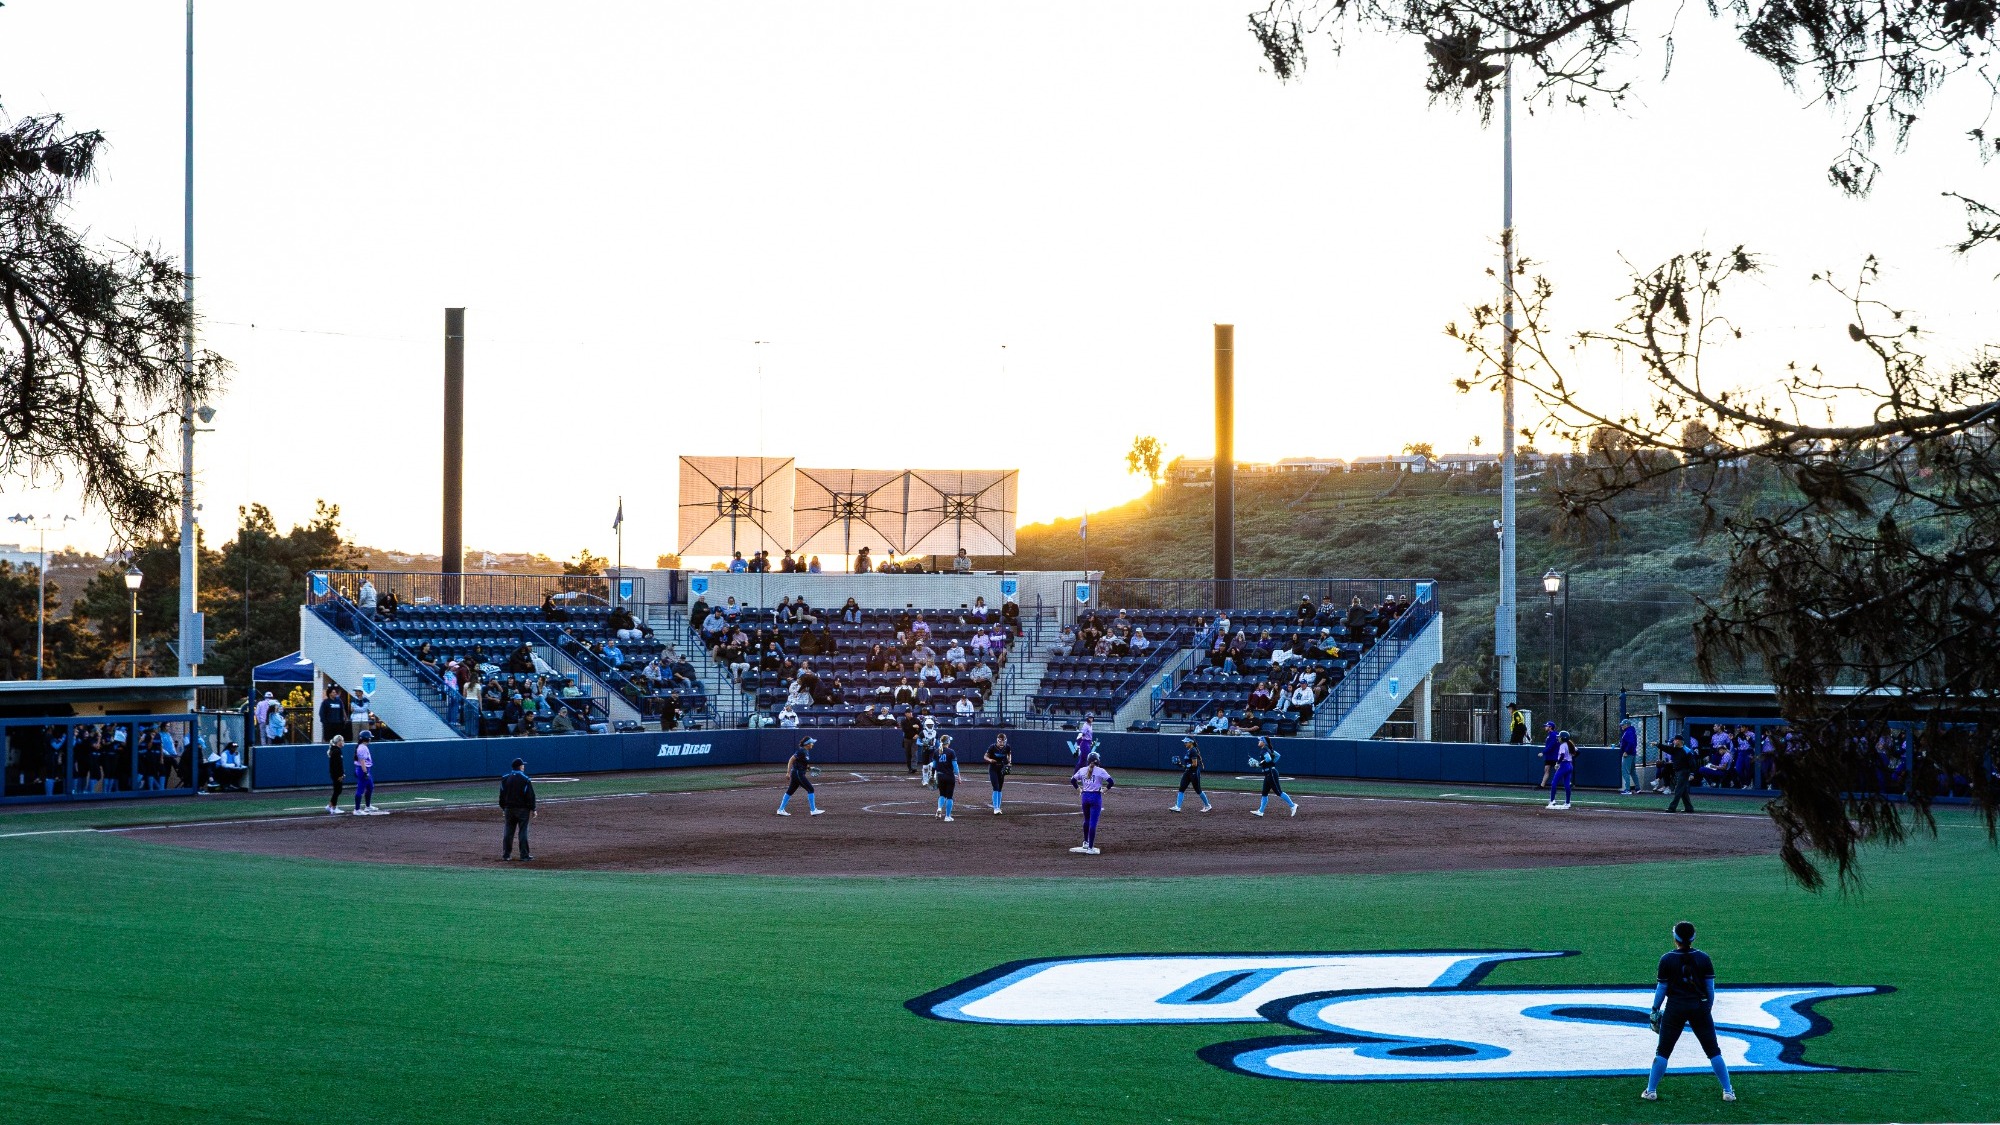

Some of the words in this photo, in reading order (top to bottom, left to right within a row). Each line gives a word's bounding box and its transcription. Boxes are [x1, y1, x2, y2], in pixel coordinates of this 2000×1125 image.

[657, 744, 681, 757] SAN
[681, 743, 712, 755] DIEGO
[938, 753, 947, 763] 20
